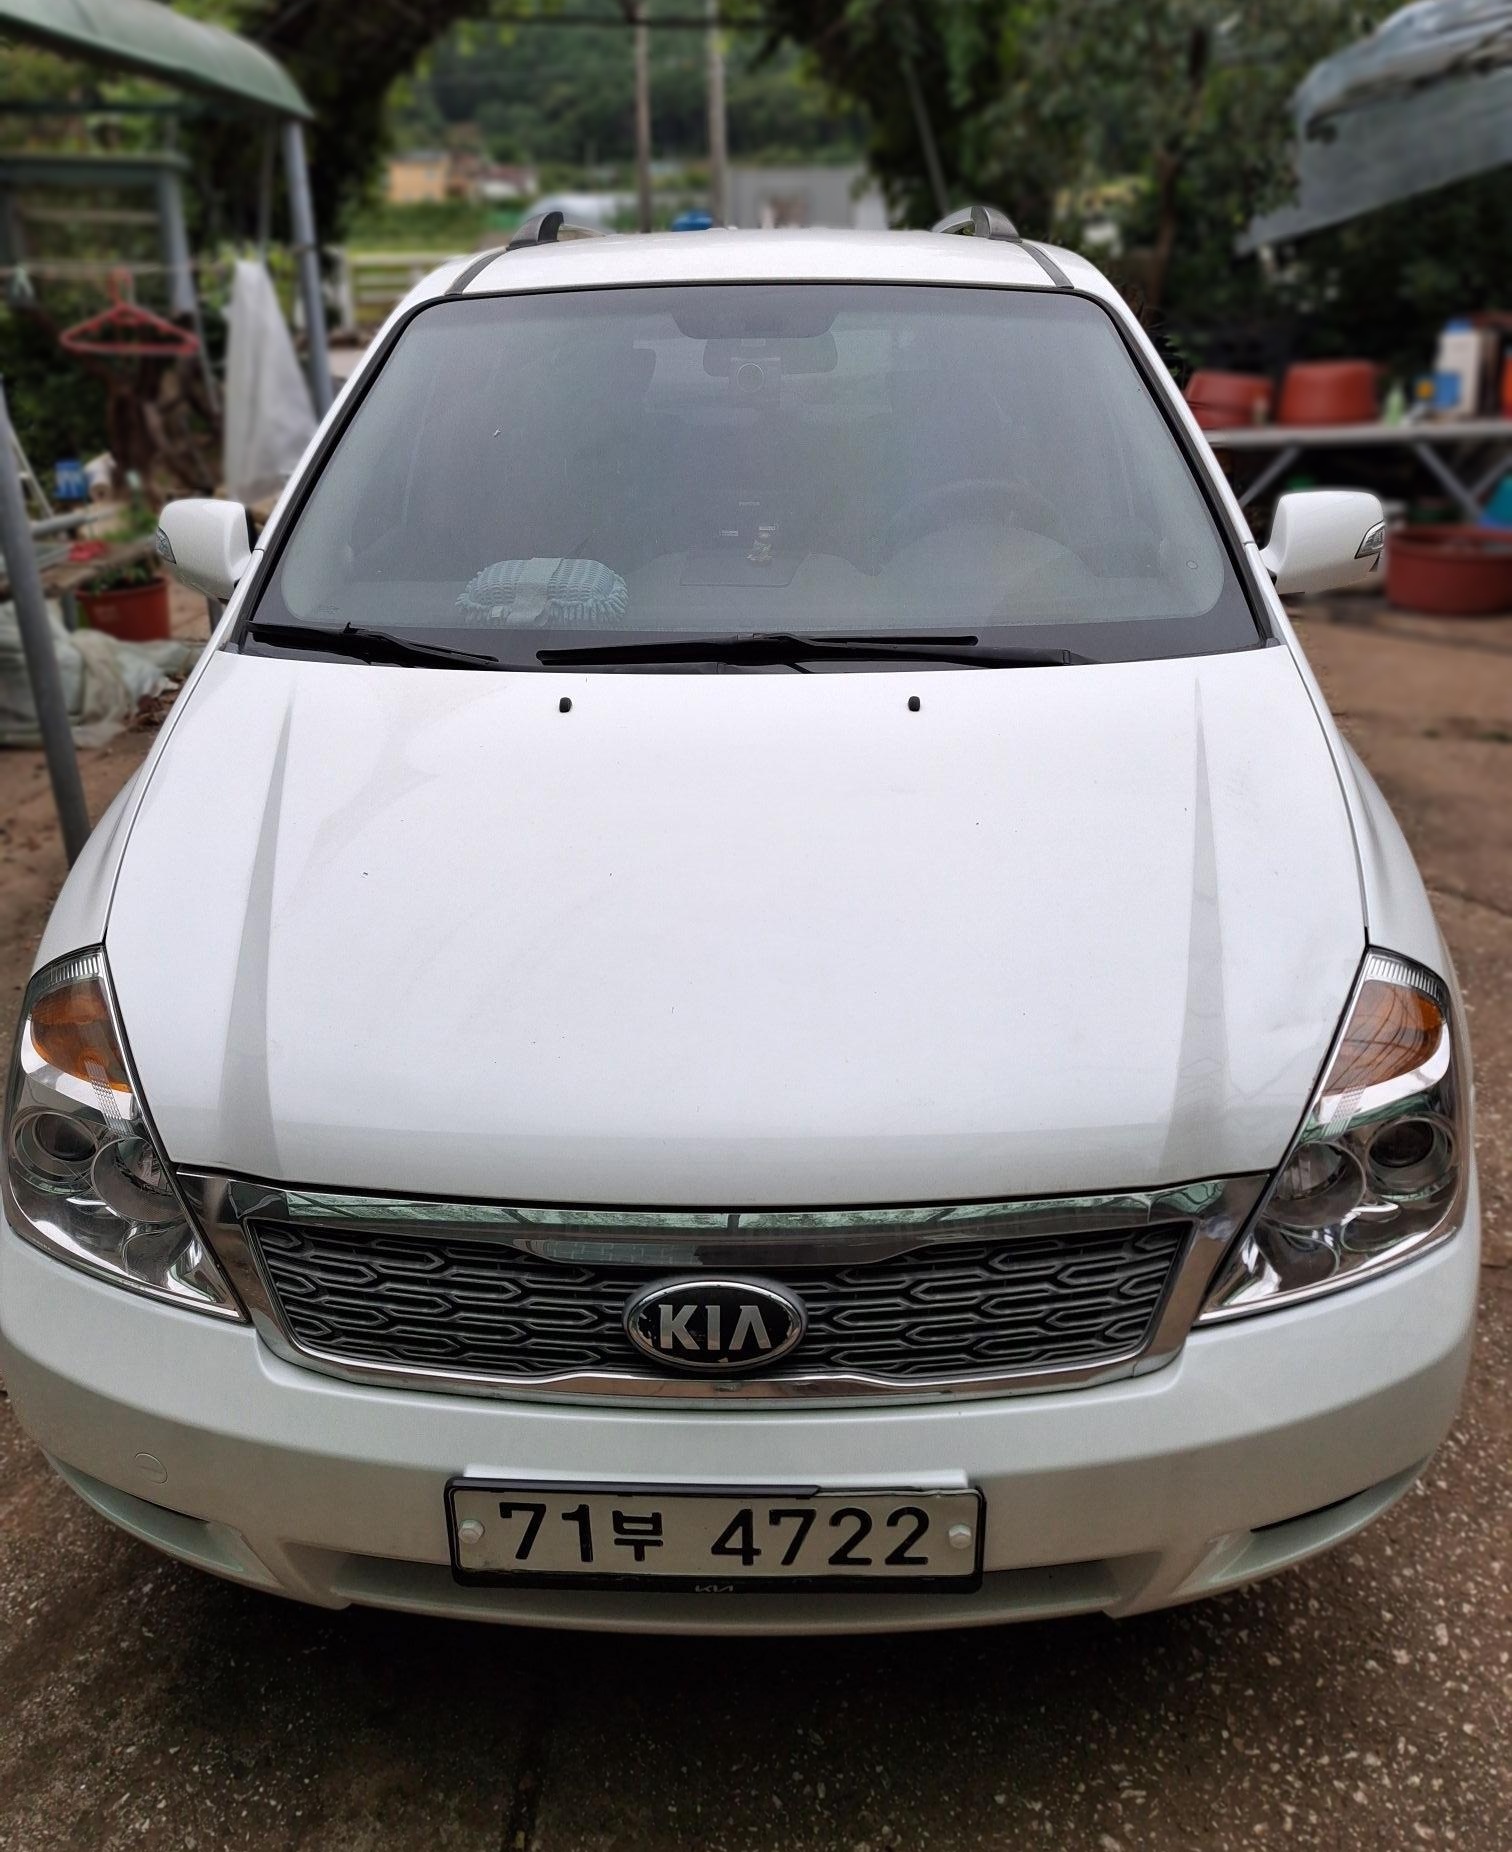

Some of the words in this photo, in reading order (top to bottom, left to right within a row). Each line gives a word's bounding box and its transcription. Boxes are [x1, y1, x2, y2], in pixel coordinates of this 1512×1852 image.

[658, 1304, 773, 1351] KIA
[499, 1502, 664, 1562] 71부
[710, 1507, 930, 1567] 4722
